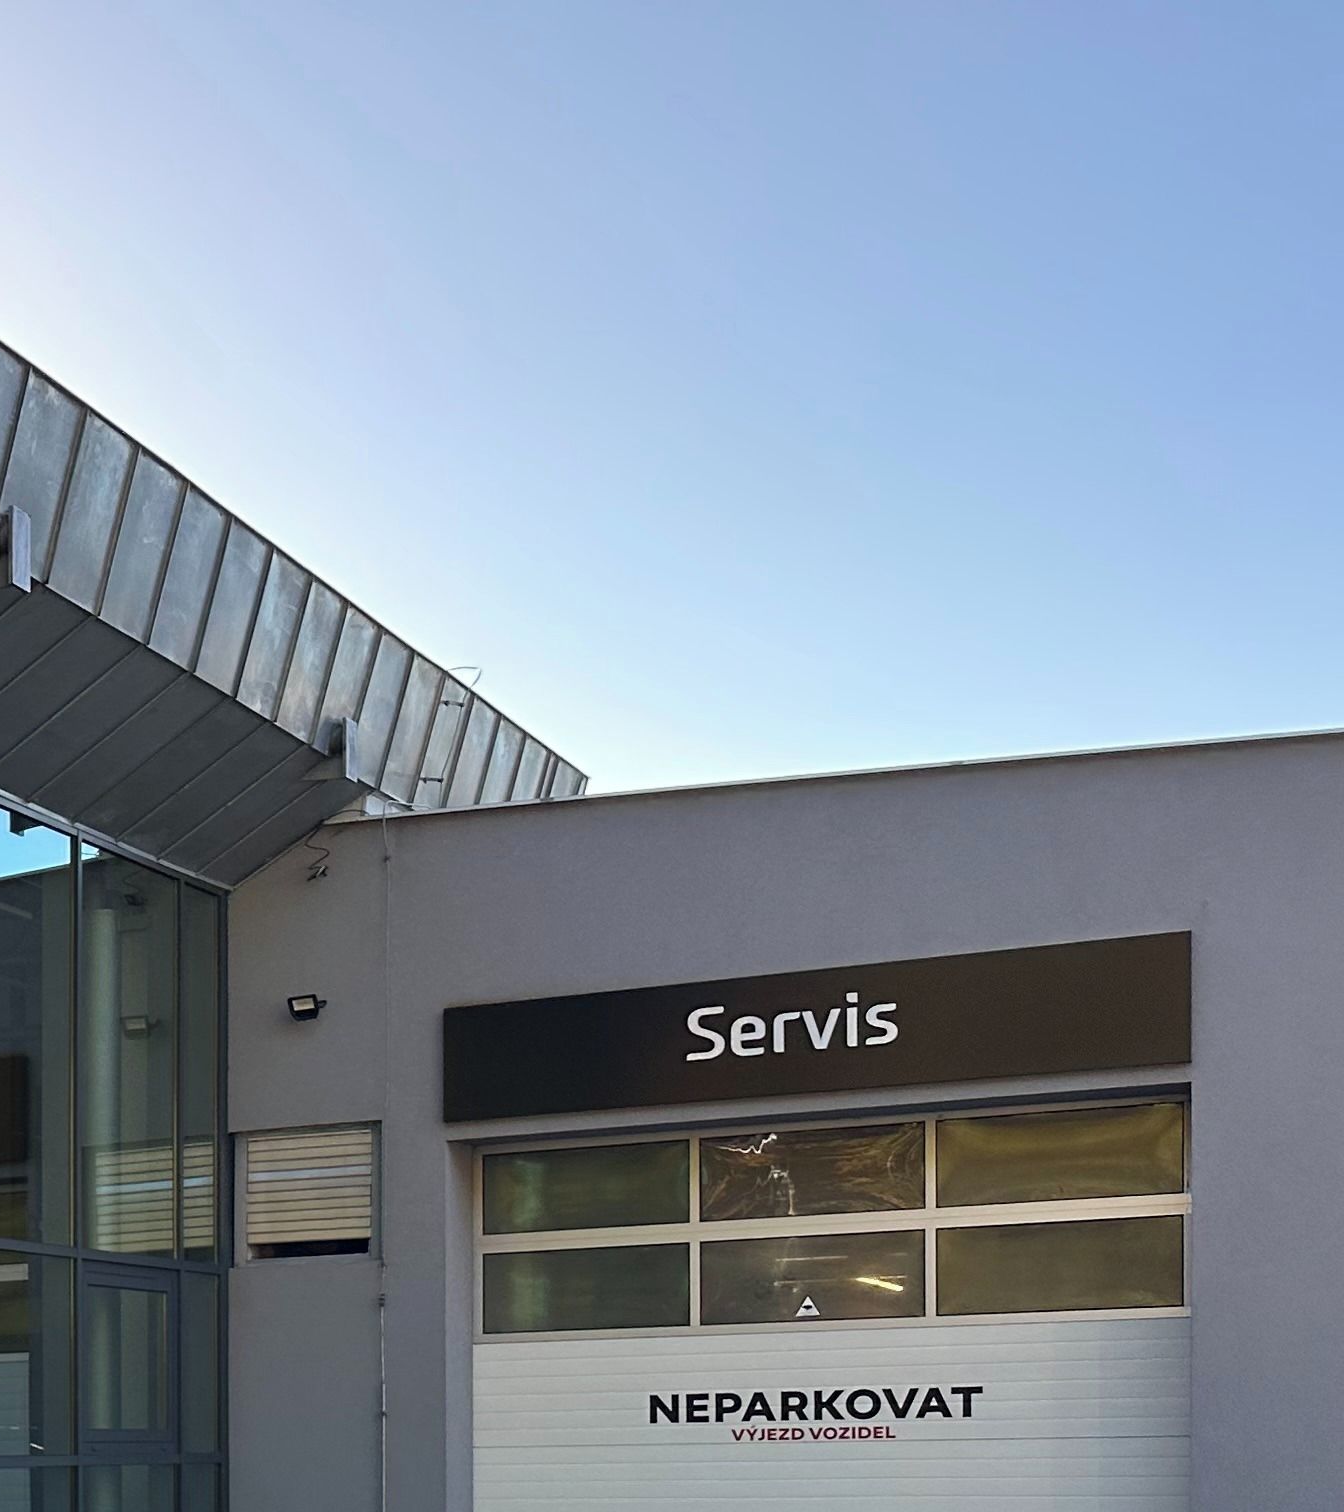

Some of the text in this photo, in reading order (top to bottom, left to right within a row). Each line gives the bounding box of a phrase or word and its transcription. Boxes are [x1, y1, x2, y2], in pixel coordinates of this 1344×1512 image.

[686, 991, 899, 1062] Servis
[649, 1386, 984, 1424] NEPARKOVAT
[731, 1425, 897, 1441] VÝJEZD VOZIDEL
